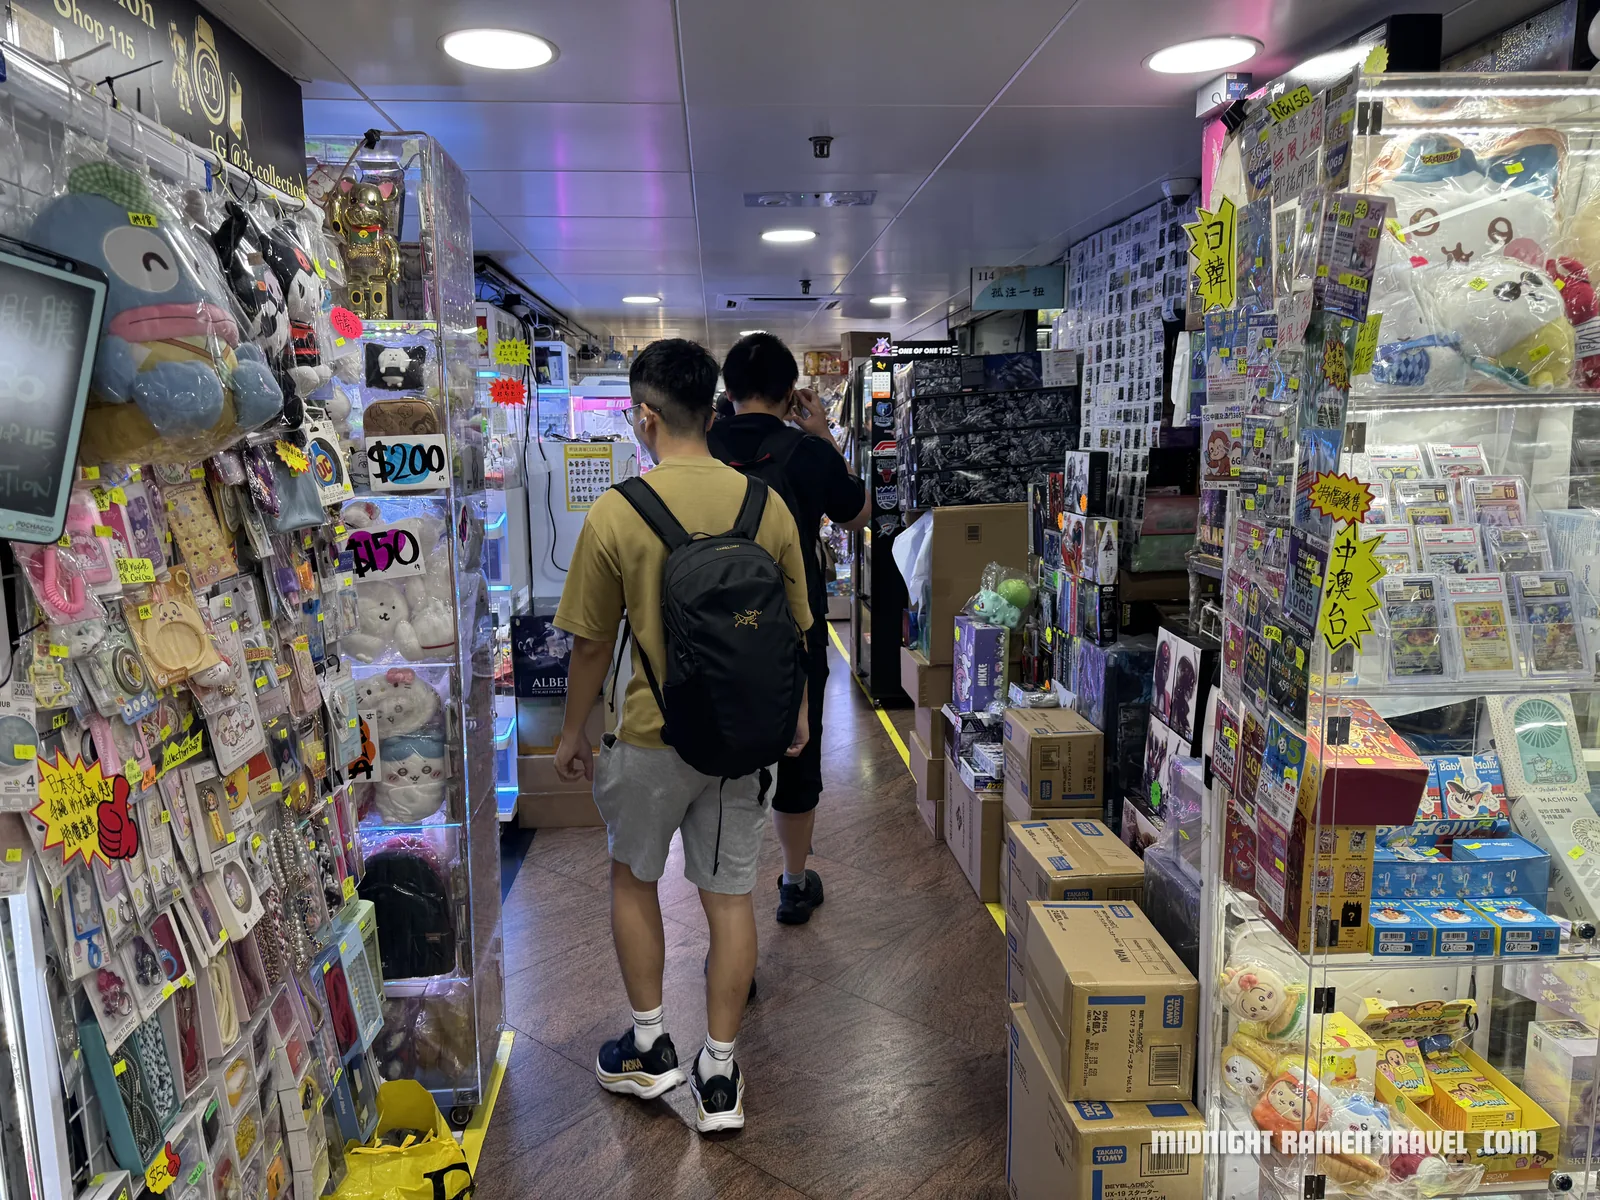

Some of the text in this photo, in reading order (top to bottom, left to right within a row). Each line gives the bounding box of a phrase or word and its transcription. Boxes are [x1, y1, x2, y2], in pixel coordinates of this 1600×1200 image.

[53, 0, 136, 60] Shop 115
[1271, 100, 1296, 120] NEW
[209, 130, 227, 160] IG
[1370, 208, 1381, 220] 5G
[978, 271, 994, 281] 114
[991, 286, 1045, 298] 孤注一扭
[367, 440, 445, 484] $200
[1435, 491, 1446, 501] 10
[1505, 488, 1515, 498] 10
[346, 528, 420, 579] $150
[1296, 584, 1314, 601] DAYS
[1326, 537, 1358, 635] 中澳台
[977, 663, 988, 687] NIKKE
[1440, 760, 1462, 772] Baby
[26, 775, 35, 788] 4
[1166, 998, 1174, 1026] TOMY
[1173, 998, 1181, 1026] TAKARA
[1092, 1010, 1101, 1037] 24個入
[1096, 1148, 1123, 1156] TAKARA
[149, 1164, 168, 1188] $50
[1128, 1189, 1159, 1197] スターター
